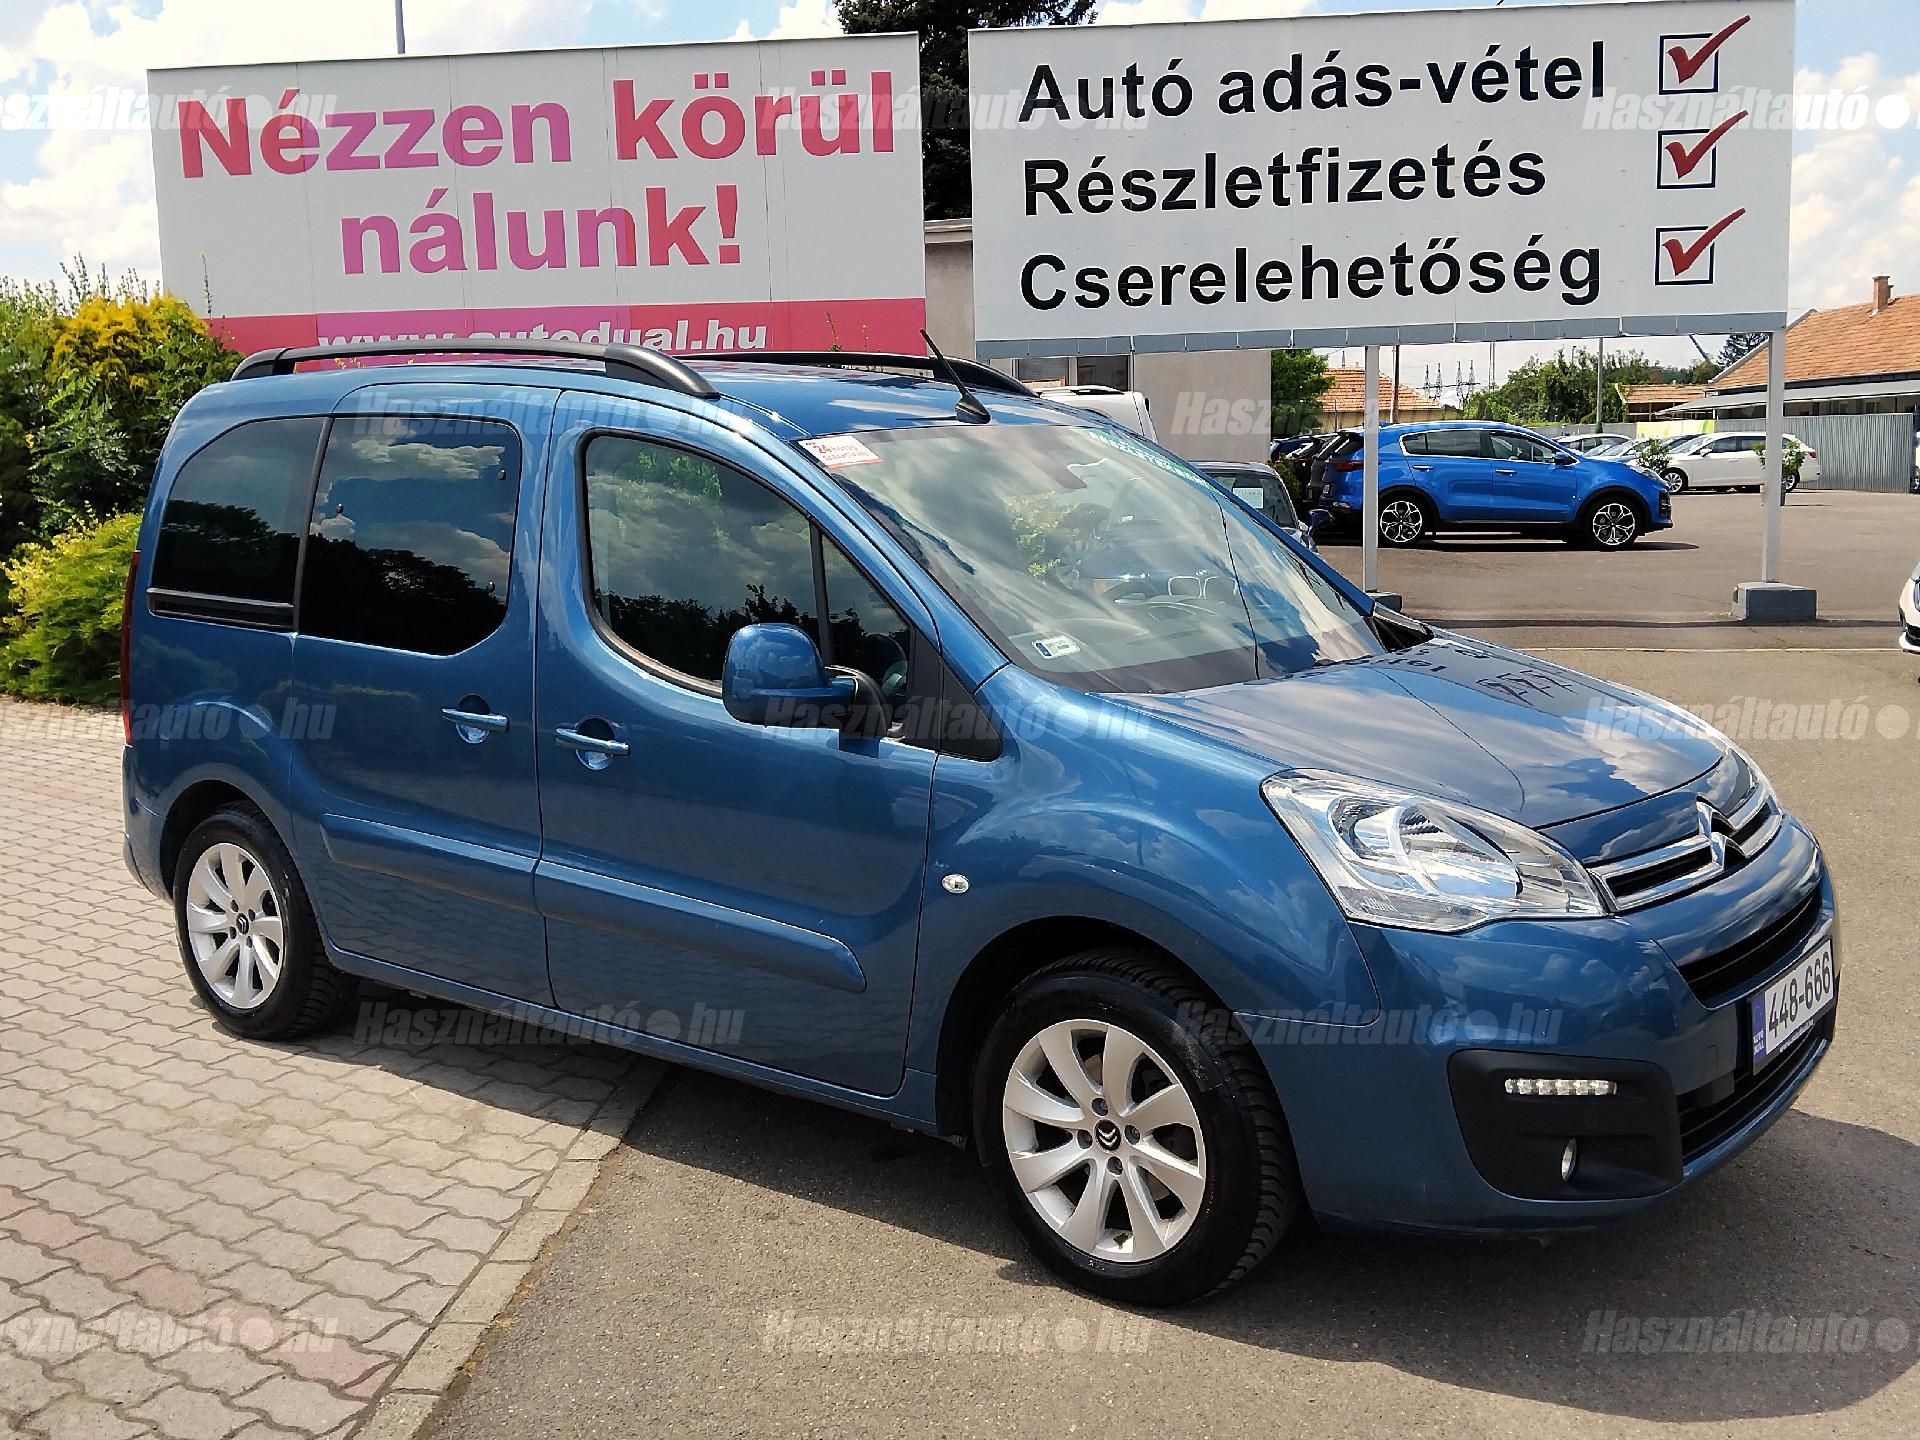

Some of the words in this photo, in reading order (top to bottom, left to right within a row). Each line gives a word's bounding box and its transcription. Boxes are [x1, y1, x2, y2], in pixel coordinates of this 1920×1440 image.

[179, 89, 570, 178] Nézzen
[614, 70, 894, 160] körül
[1019, 59, 1192, 122] Autó
[1219, 41, 1603, 115] adás-vétel
[1025, 139, 1545, 216] Részletfizetés
[342, 185, 739, 274] nálunk!
[1021, 234, 1599, 310] Cserelehetőség
[1767, 950, 1831, 1039] 448-666
